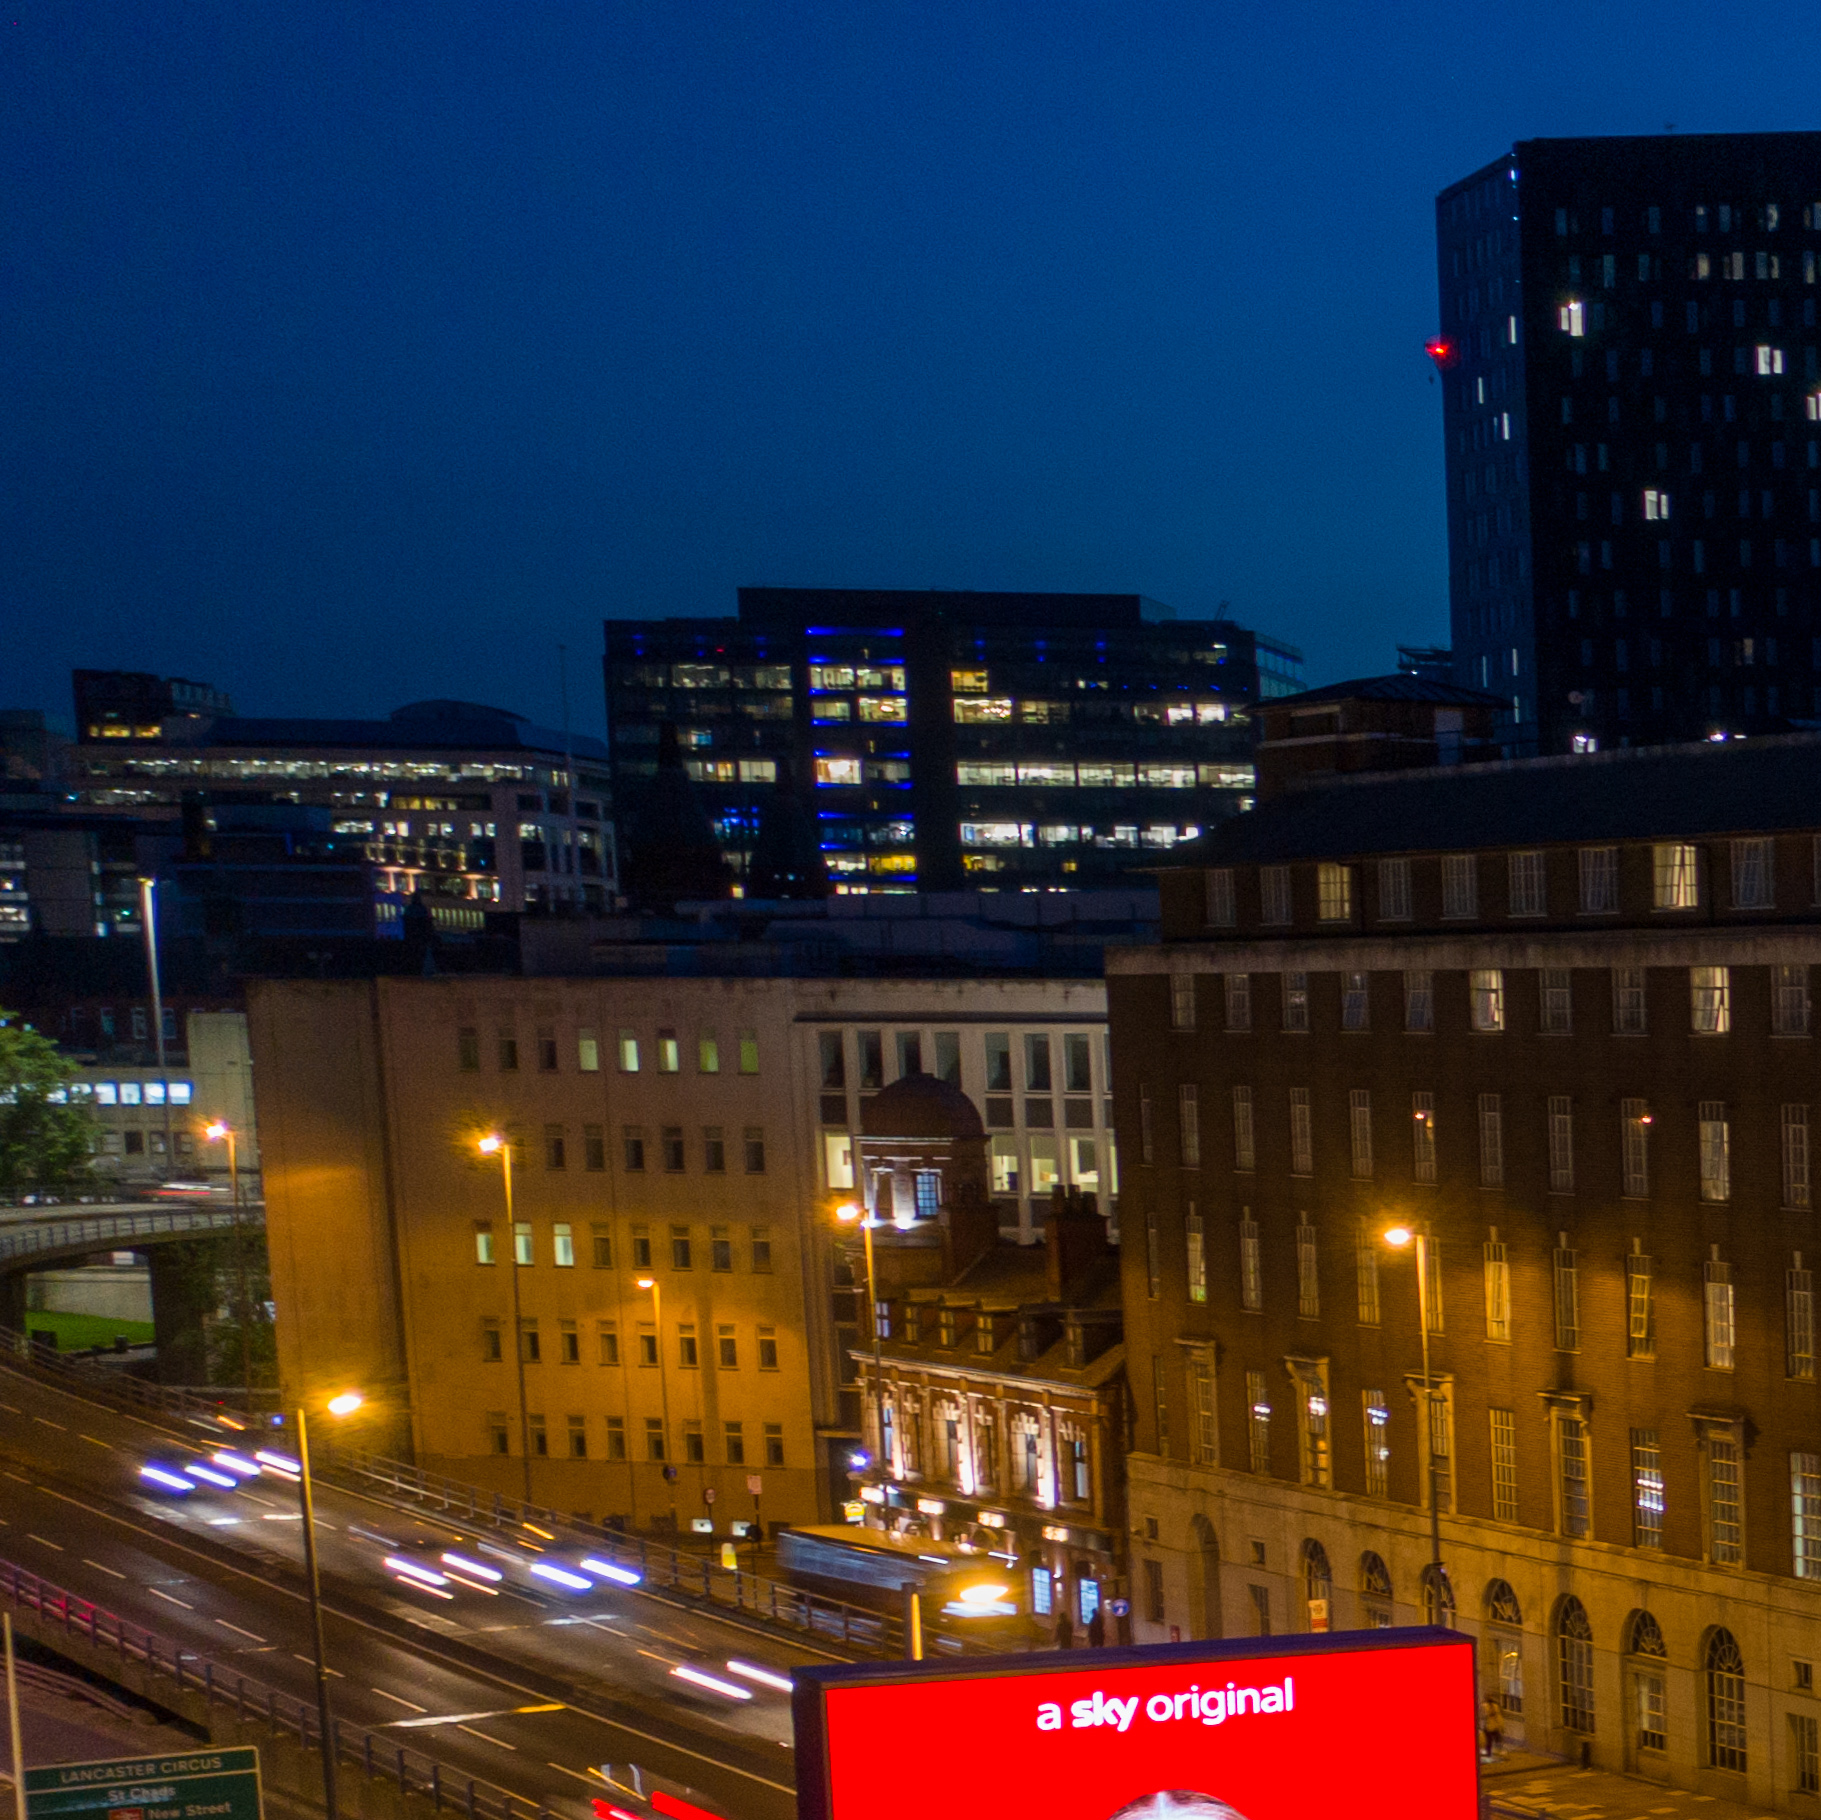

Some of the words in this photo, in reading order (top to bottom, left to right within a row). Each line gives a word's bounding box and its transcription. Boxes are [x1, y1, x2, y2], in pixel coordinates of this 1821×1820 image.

[1037, 1702, 1062, 1731] a
[1070, 1691, 1139, 1732] sky
[1146, 1677, 1294, 1726] original
[60, 1763, 156, 1784] LANCASTER
[161, 1757, 222, 1774] CIRCUS
[148, 1808, 181, 1820] New
[185, 1801, 232, 1817] Street
